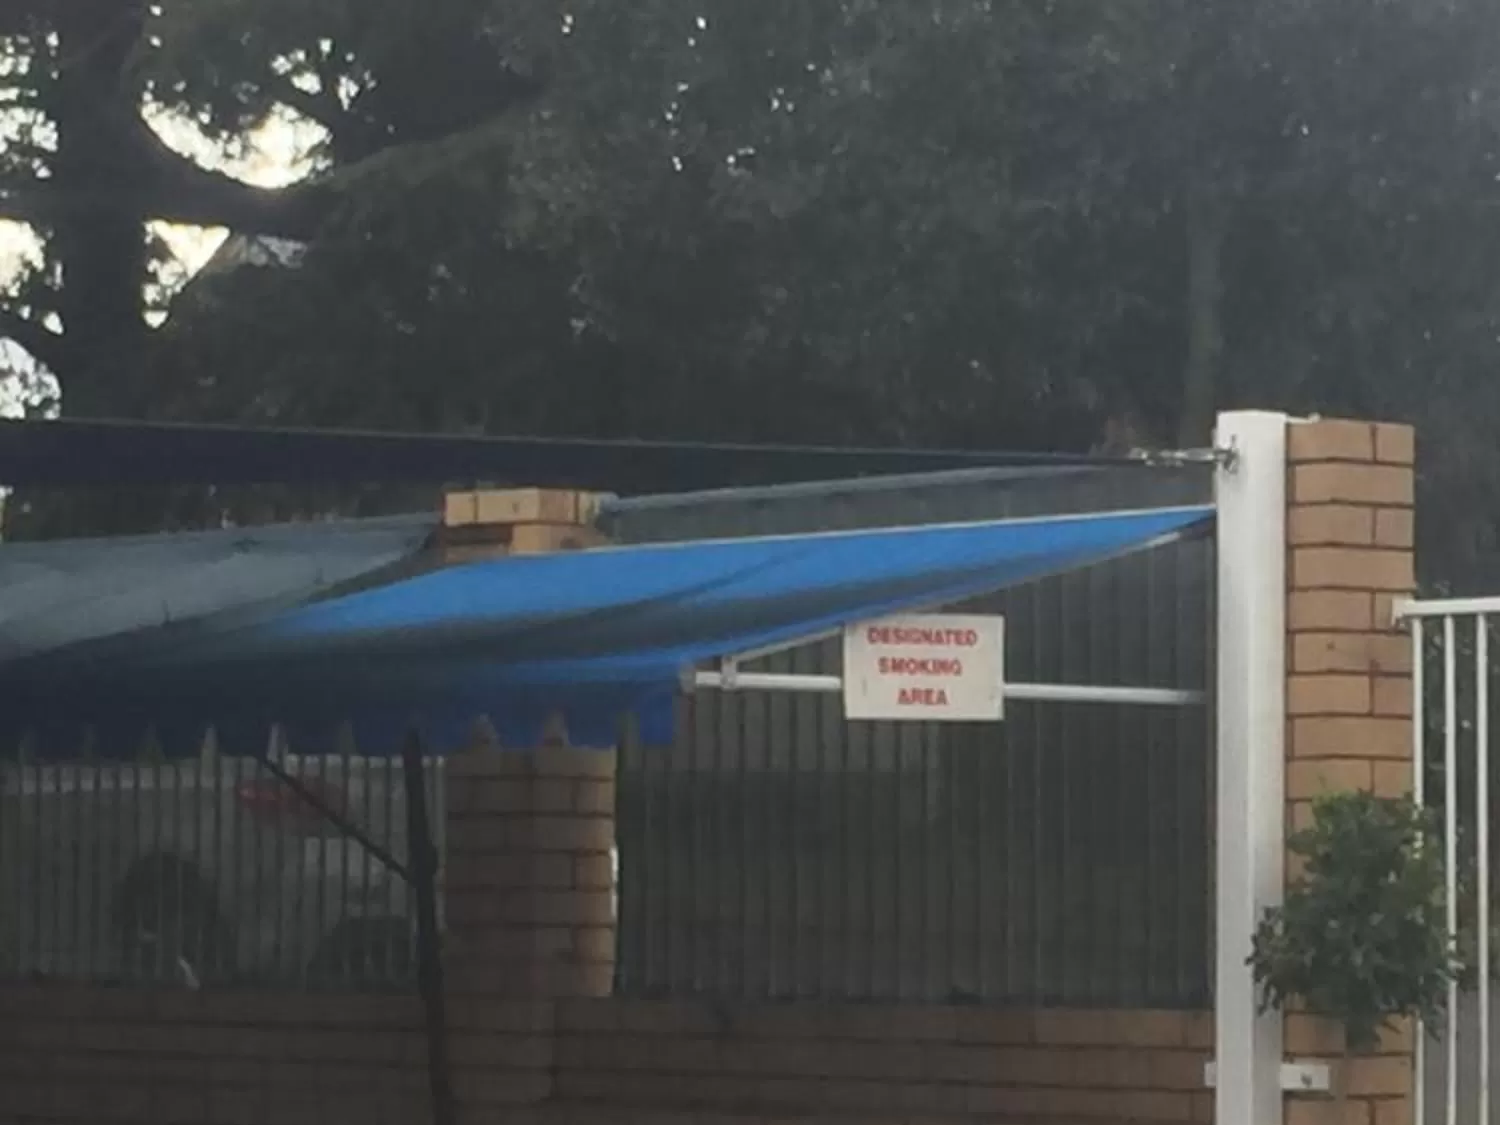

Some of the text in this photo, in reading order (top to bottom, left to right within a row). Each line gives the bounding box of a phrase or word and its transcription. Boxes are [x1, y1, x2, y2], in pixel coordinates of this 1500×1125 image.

[867, 627, 978, 646] DESIGNATED
[877, 656, 963, 676] SMOKING
[897, 688, 948, 705] AREA
